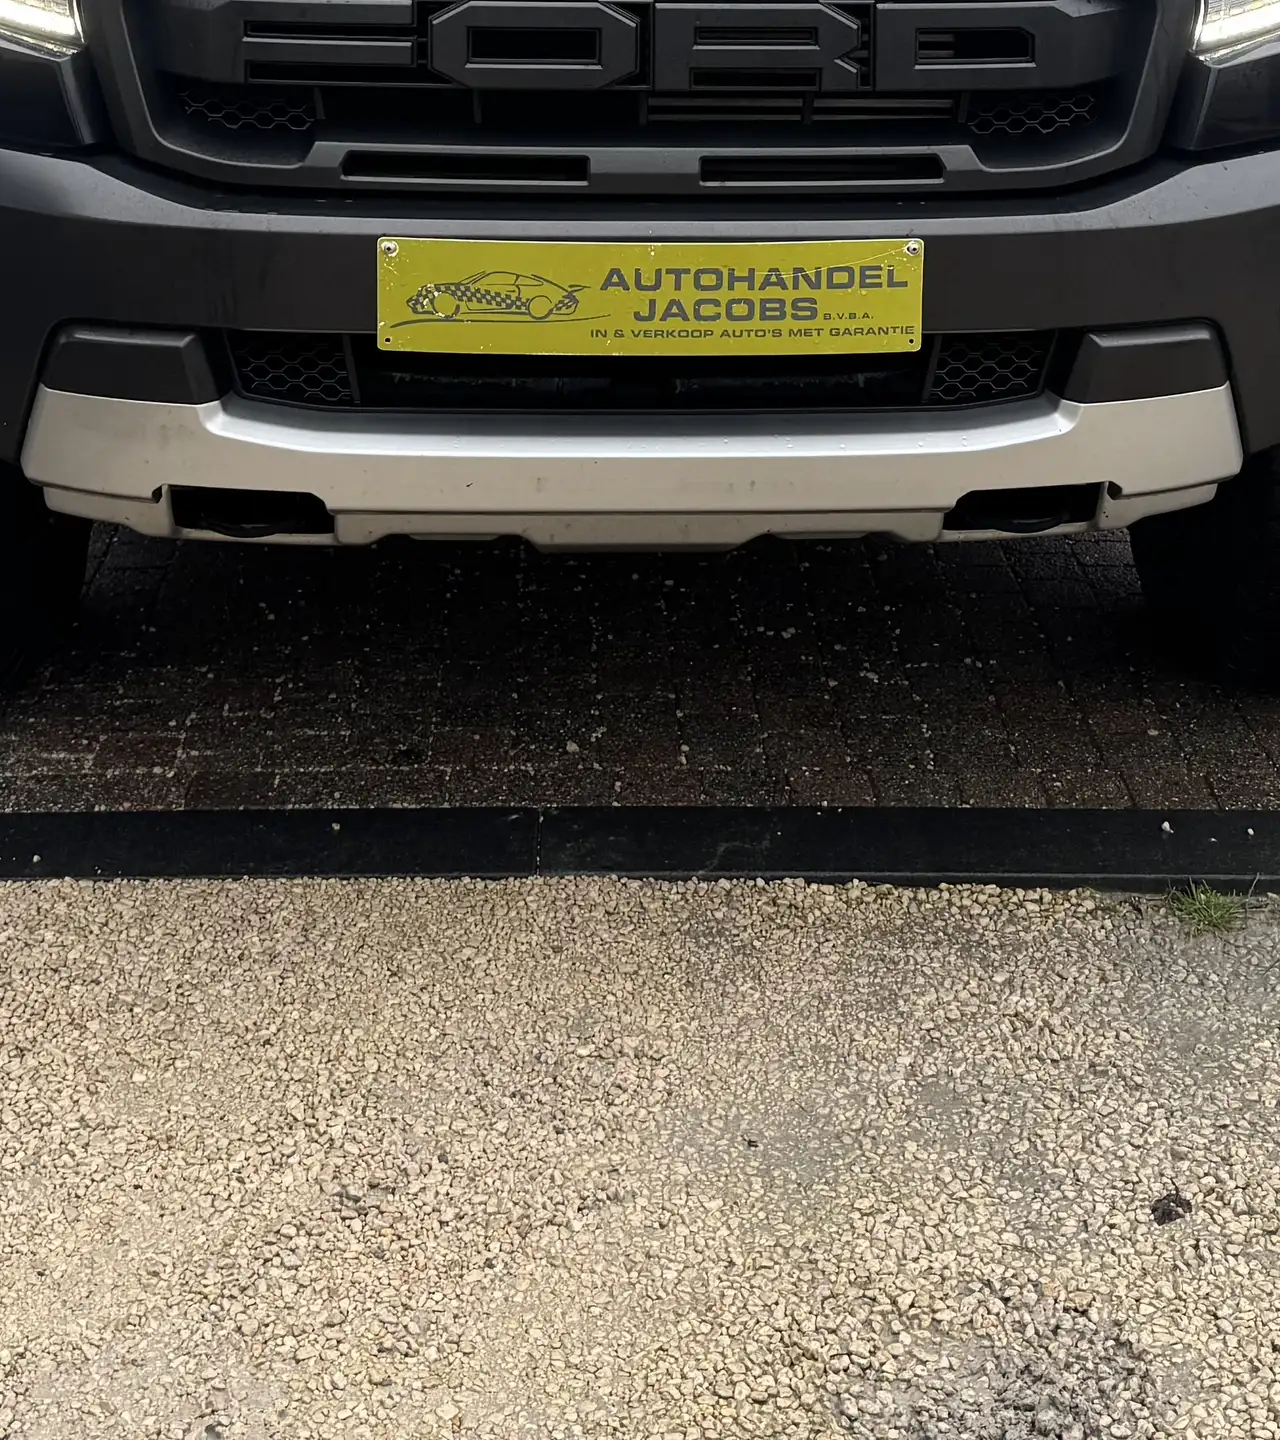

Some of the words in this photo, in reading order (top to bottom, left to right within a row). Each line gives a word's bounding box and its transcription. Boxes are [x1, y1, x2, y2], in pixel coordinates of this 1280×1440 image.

[600, 264, 908, 292] AUTOHANDEL
[633, 297, 818, 322] JACOBS
[823, 312, 874, 321] B.V.B.A.
[590, 328, 608, 339] IN
[613, 328, 625, 339] &
[631, 328, 714, 339] VERKOOP
[719, 328, 783, 338] AUTO'S
[788, 327, 824, 338] MET
[829, 325, 915, 337] GARANTIE
